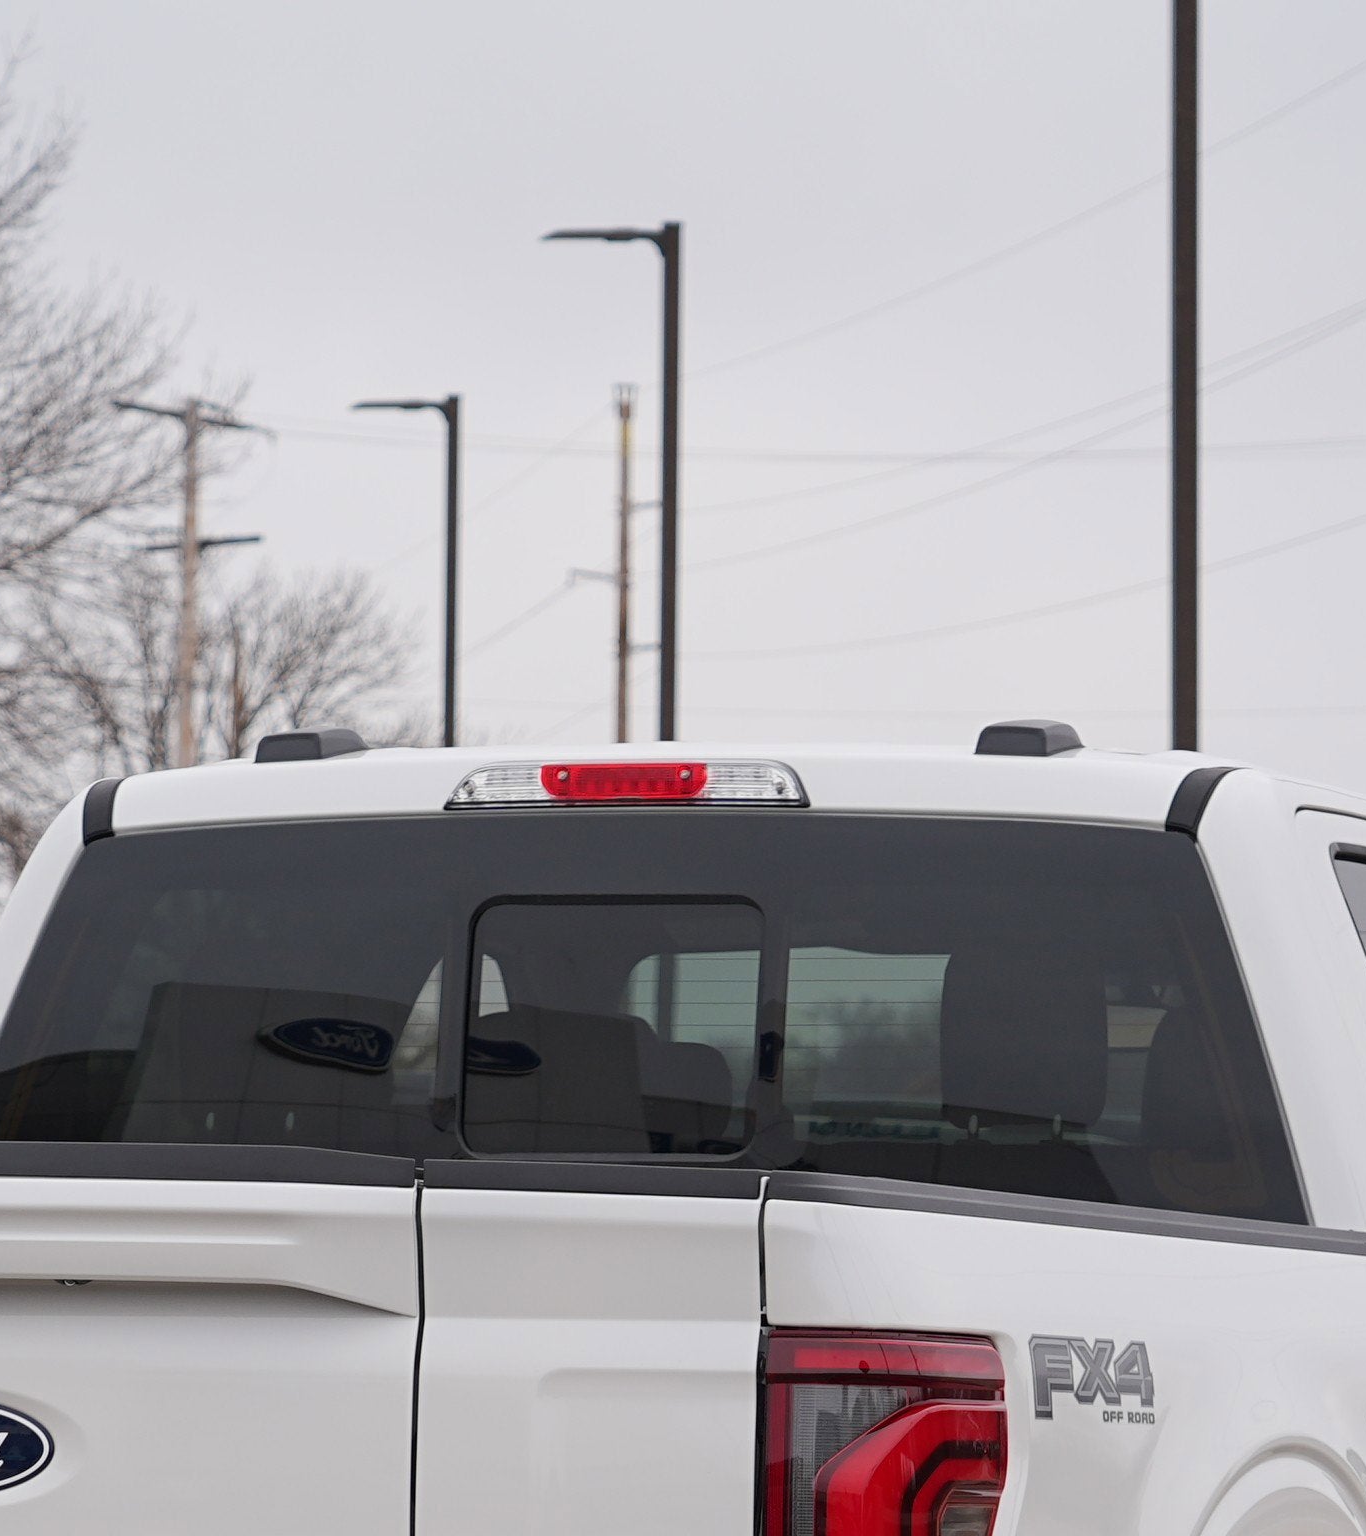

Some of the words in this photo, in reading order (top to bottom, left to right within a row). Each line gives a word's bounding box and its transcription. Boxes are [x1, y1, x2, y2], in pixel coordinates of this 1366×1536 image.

[1029, 1334, 1155, 1420] FX4
[1103, 1411, 1123, 1423] OFF
[1128, 1411, 1155, 1424] ROAD
